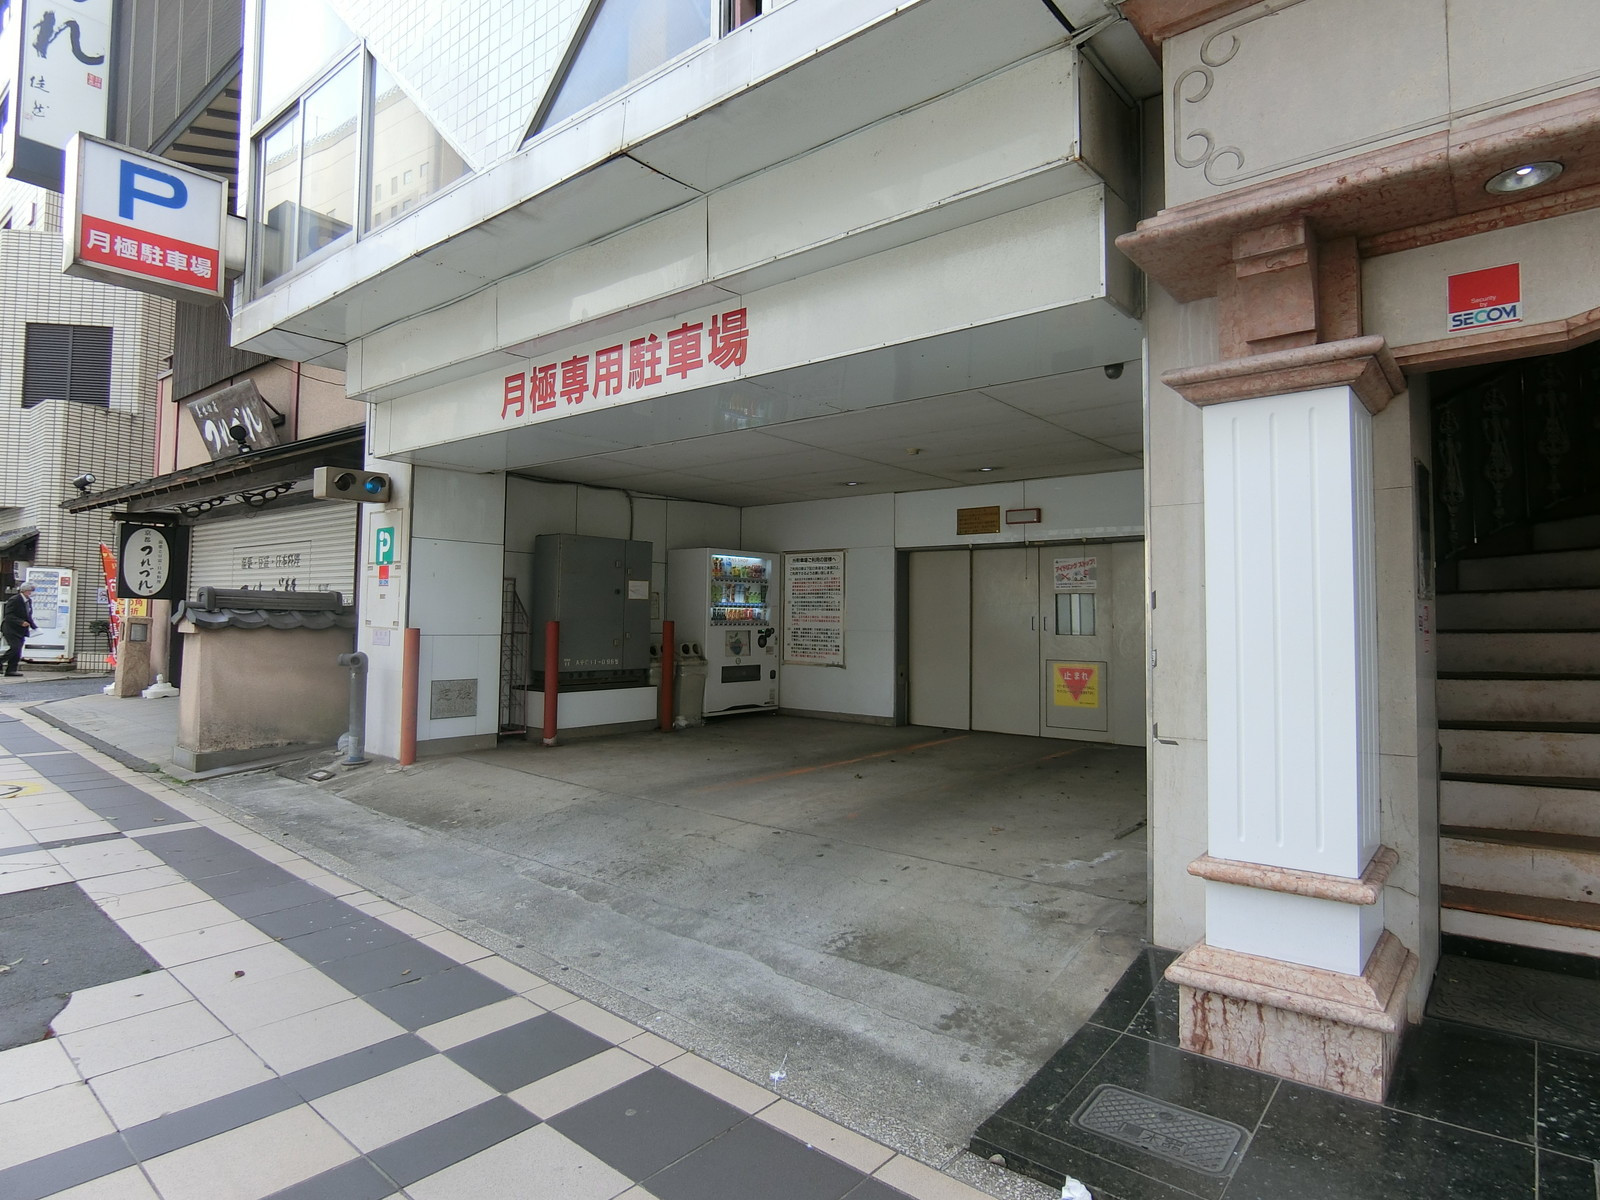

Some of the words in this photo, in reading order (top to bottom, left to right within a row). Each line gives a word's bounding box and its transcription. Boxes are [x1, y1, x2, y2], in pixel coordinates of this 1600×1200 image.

[118, 159, 188, 221] P
[87, 229, 212, 278] 月極駐車場
[1452, 304, 1517, 327] SECOM
[501, 307, 749, 420] 月極専用駐車場
[138, 545, 154, 591] つれづれ
[1063, 671, 1089, 681] 止まれ
